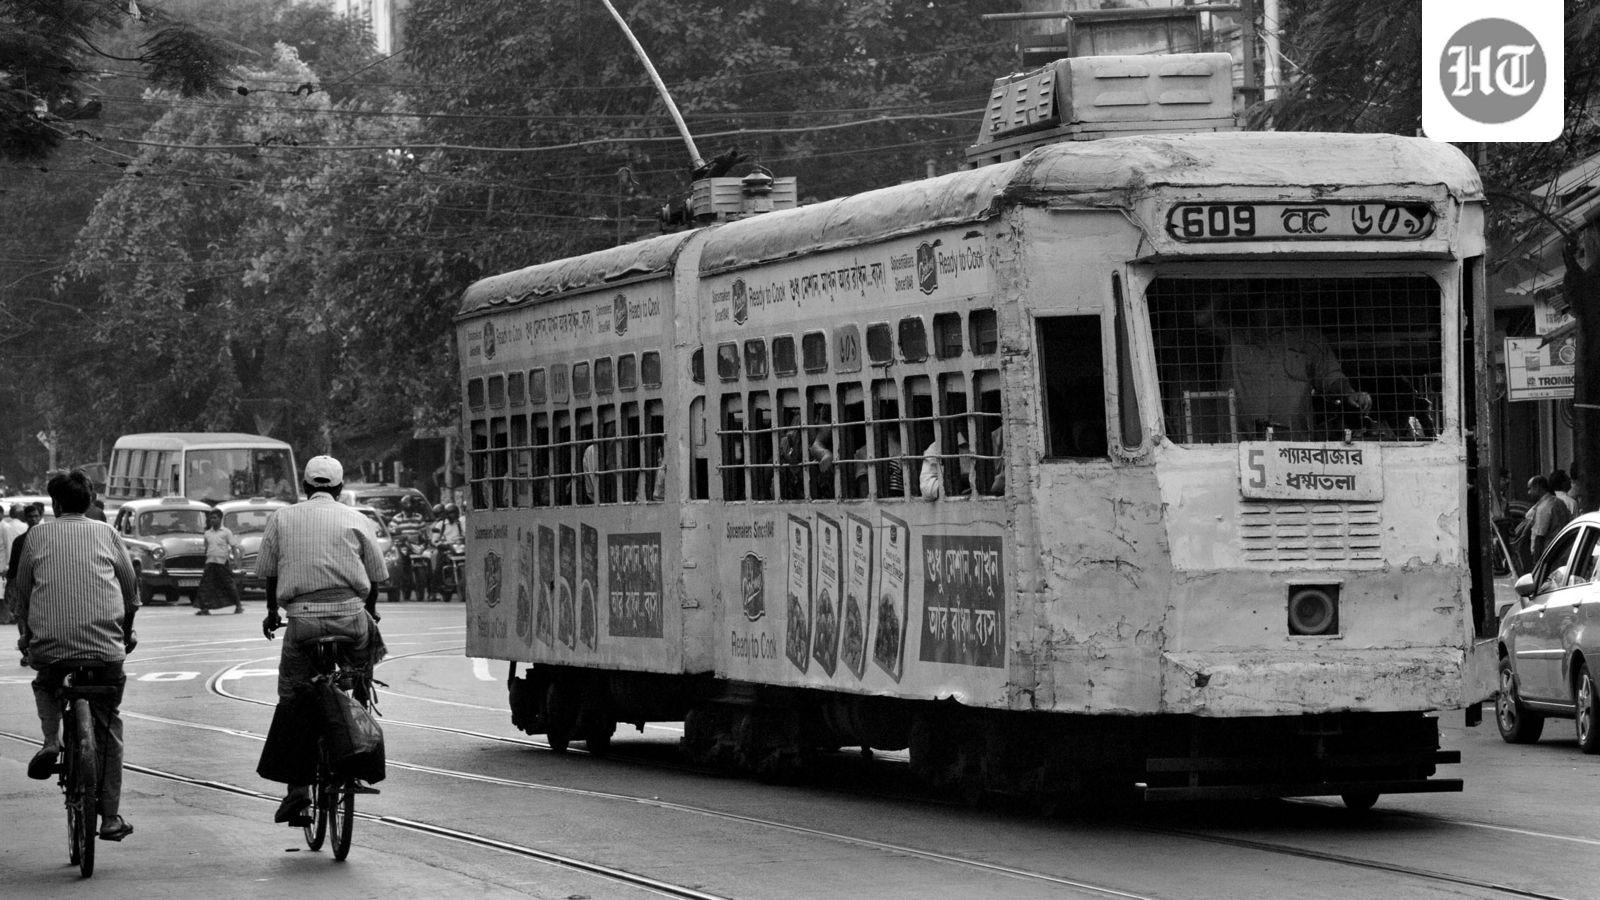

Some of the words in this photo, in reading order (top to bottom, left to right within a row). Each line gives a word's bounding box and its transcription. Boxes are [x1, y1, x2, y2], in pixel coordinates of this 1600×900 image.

[1182, 205, 1256, 236] 609
[938, 251, 958, 279] Ready
[959, 249, 966, 271] to
[967, 245, 985, 269] Cook
[749, 285, 765, 311] Ready
[766, 285, 772, 304] to
[772, 281, 786, 304] Cook
[1249, 449, 1266, 489] 5
[1279, 447, 1363, 466] শ্যামবাজার
[928, 602, 948, 641] আর
[731, 630, 751, 665] Ready
[751, 633, 760, 659] to
[760, 631, 778, 660] Cook
